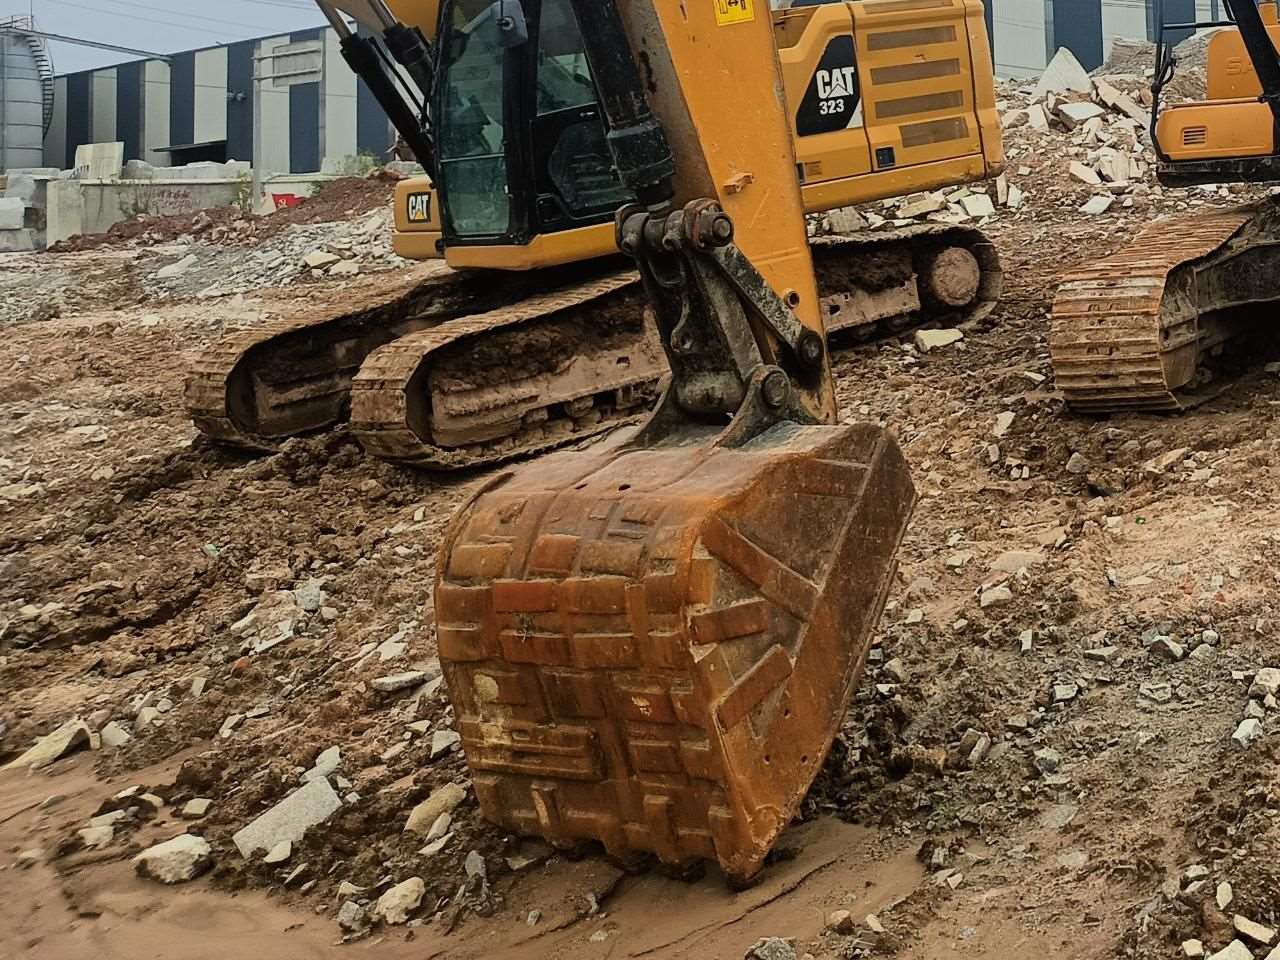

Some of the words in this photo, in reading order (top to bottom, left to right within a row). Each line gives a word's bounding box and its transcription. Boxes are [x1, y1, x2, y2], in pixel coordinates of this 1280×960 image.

[815, 66, 855, 99] CAT
[819, 99, 845, 115] 323
[408, 194, 429, 221] CAT
